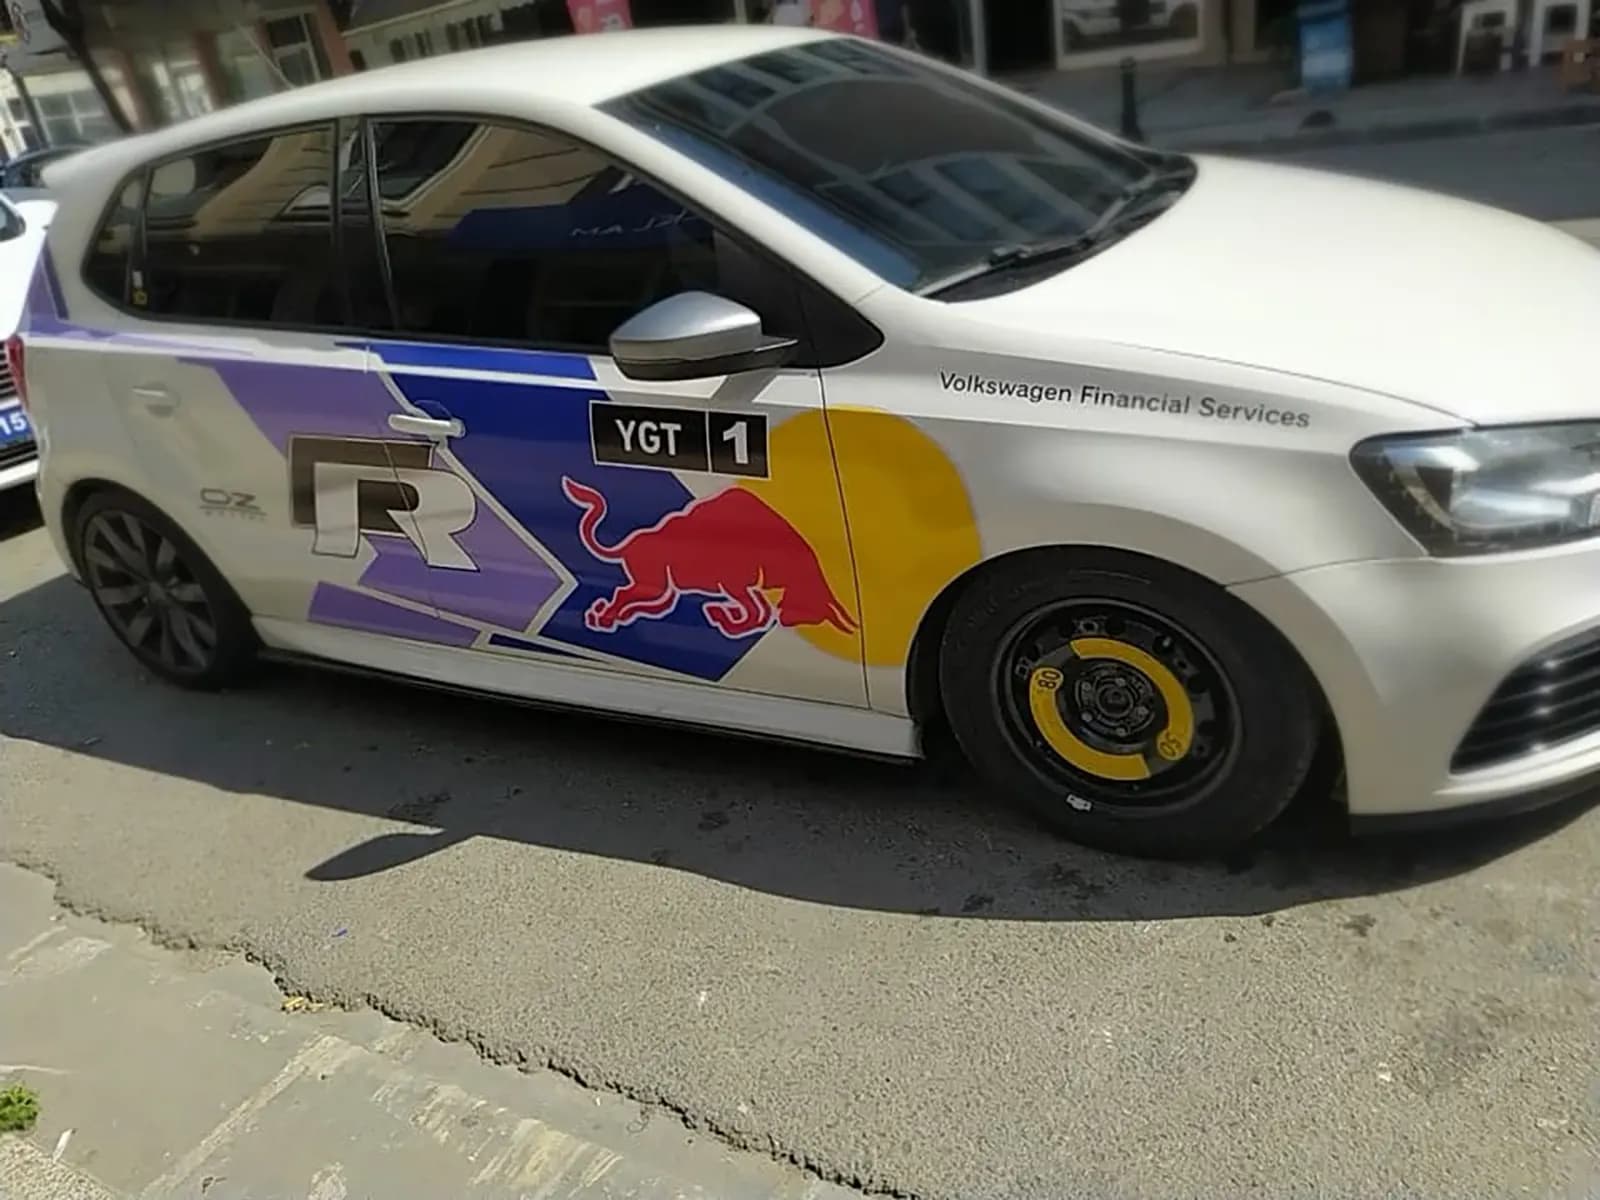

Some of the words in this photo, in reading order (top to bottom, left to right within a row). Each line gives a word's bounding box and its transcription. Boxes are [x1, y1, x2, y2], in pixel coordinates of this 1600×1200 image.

[940, 371, 1072, 404] Volkswagen
[1080, 385, 1190, 415] Financial
[1198, 396, 1311, 428] Services
[614, 418, 682, 456] YGT
[722, 420, 749, 464] 1
[311, 460, 480, 572] R
[1037, 669, 1061, 689] 80
